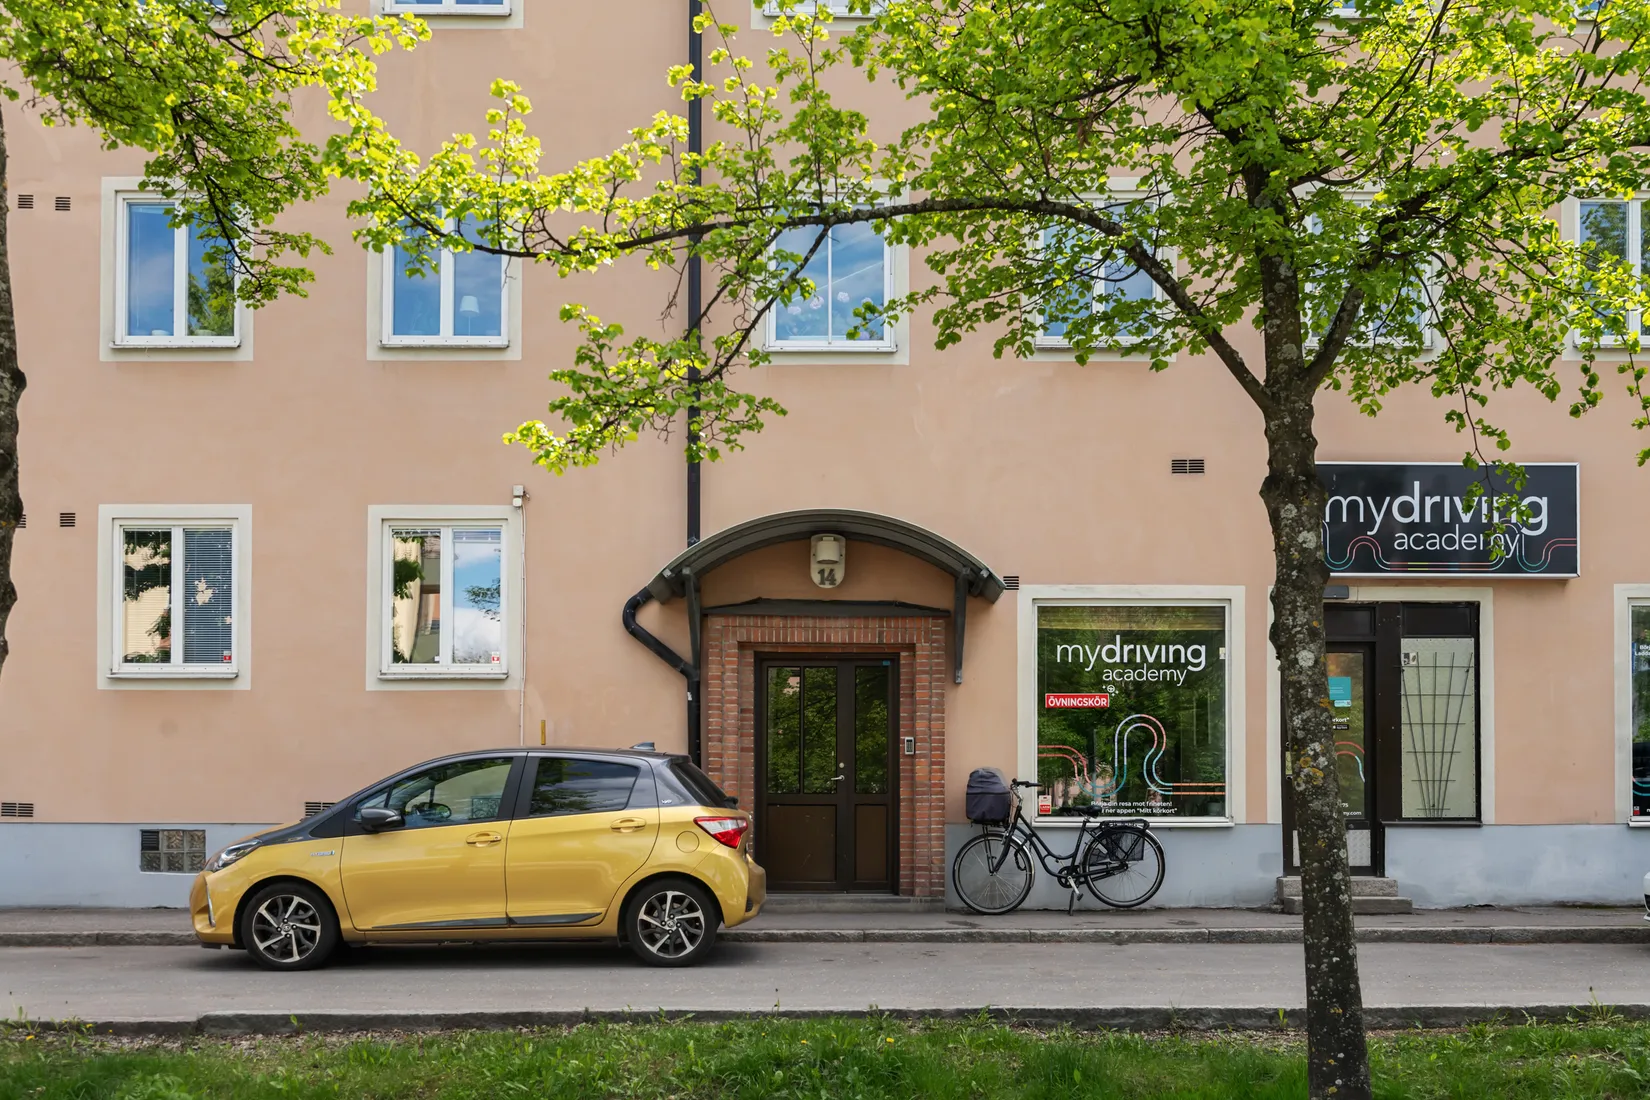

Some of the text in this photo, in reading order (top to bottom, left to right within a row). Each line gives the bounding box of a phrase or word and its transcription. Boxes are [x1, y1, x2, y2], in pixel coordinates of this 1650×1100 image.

[1325, 480, 1548, 536] mydriving
[1394, 524, 1520, 559] academy
[817, 568, 837, 586] 14
[1056, 635, 1206, 671] mydriving
[1102, 662, 1188, 687] academy
[1048, 696, 1107, 707] ÖVNINGSKÖR
